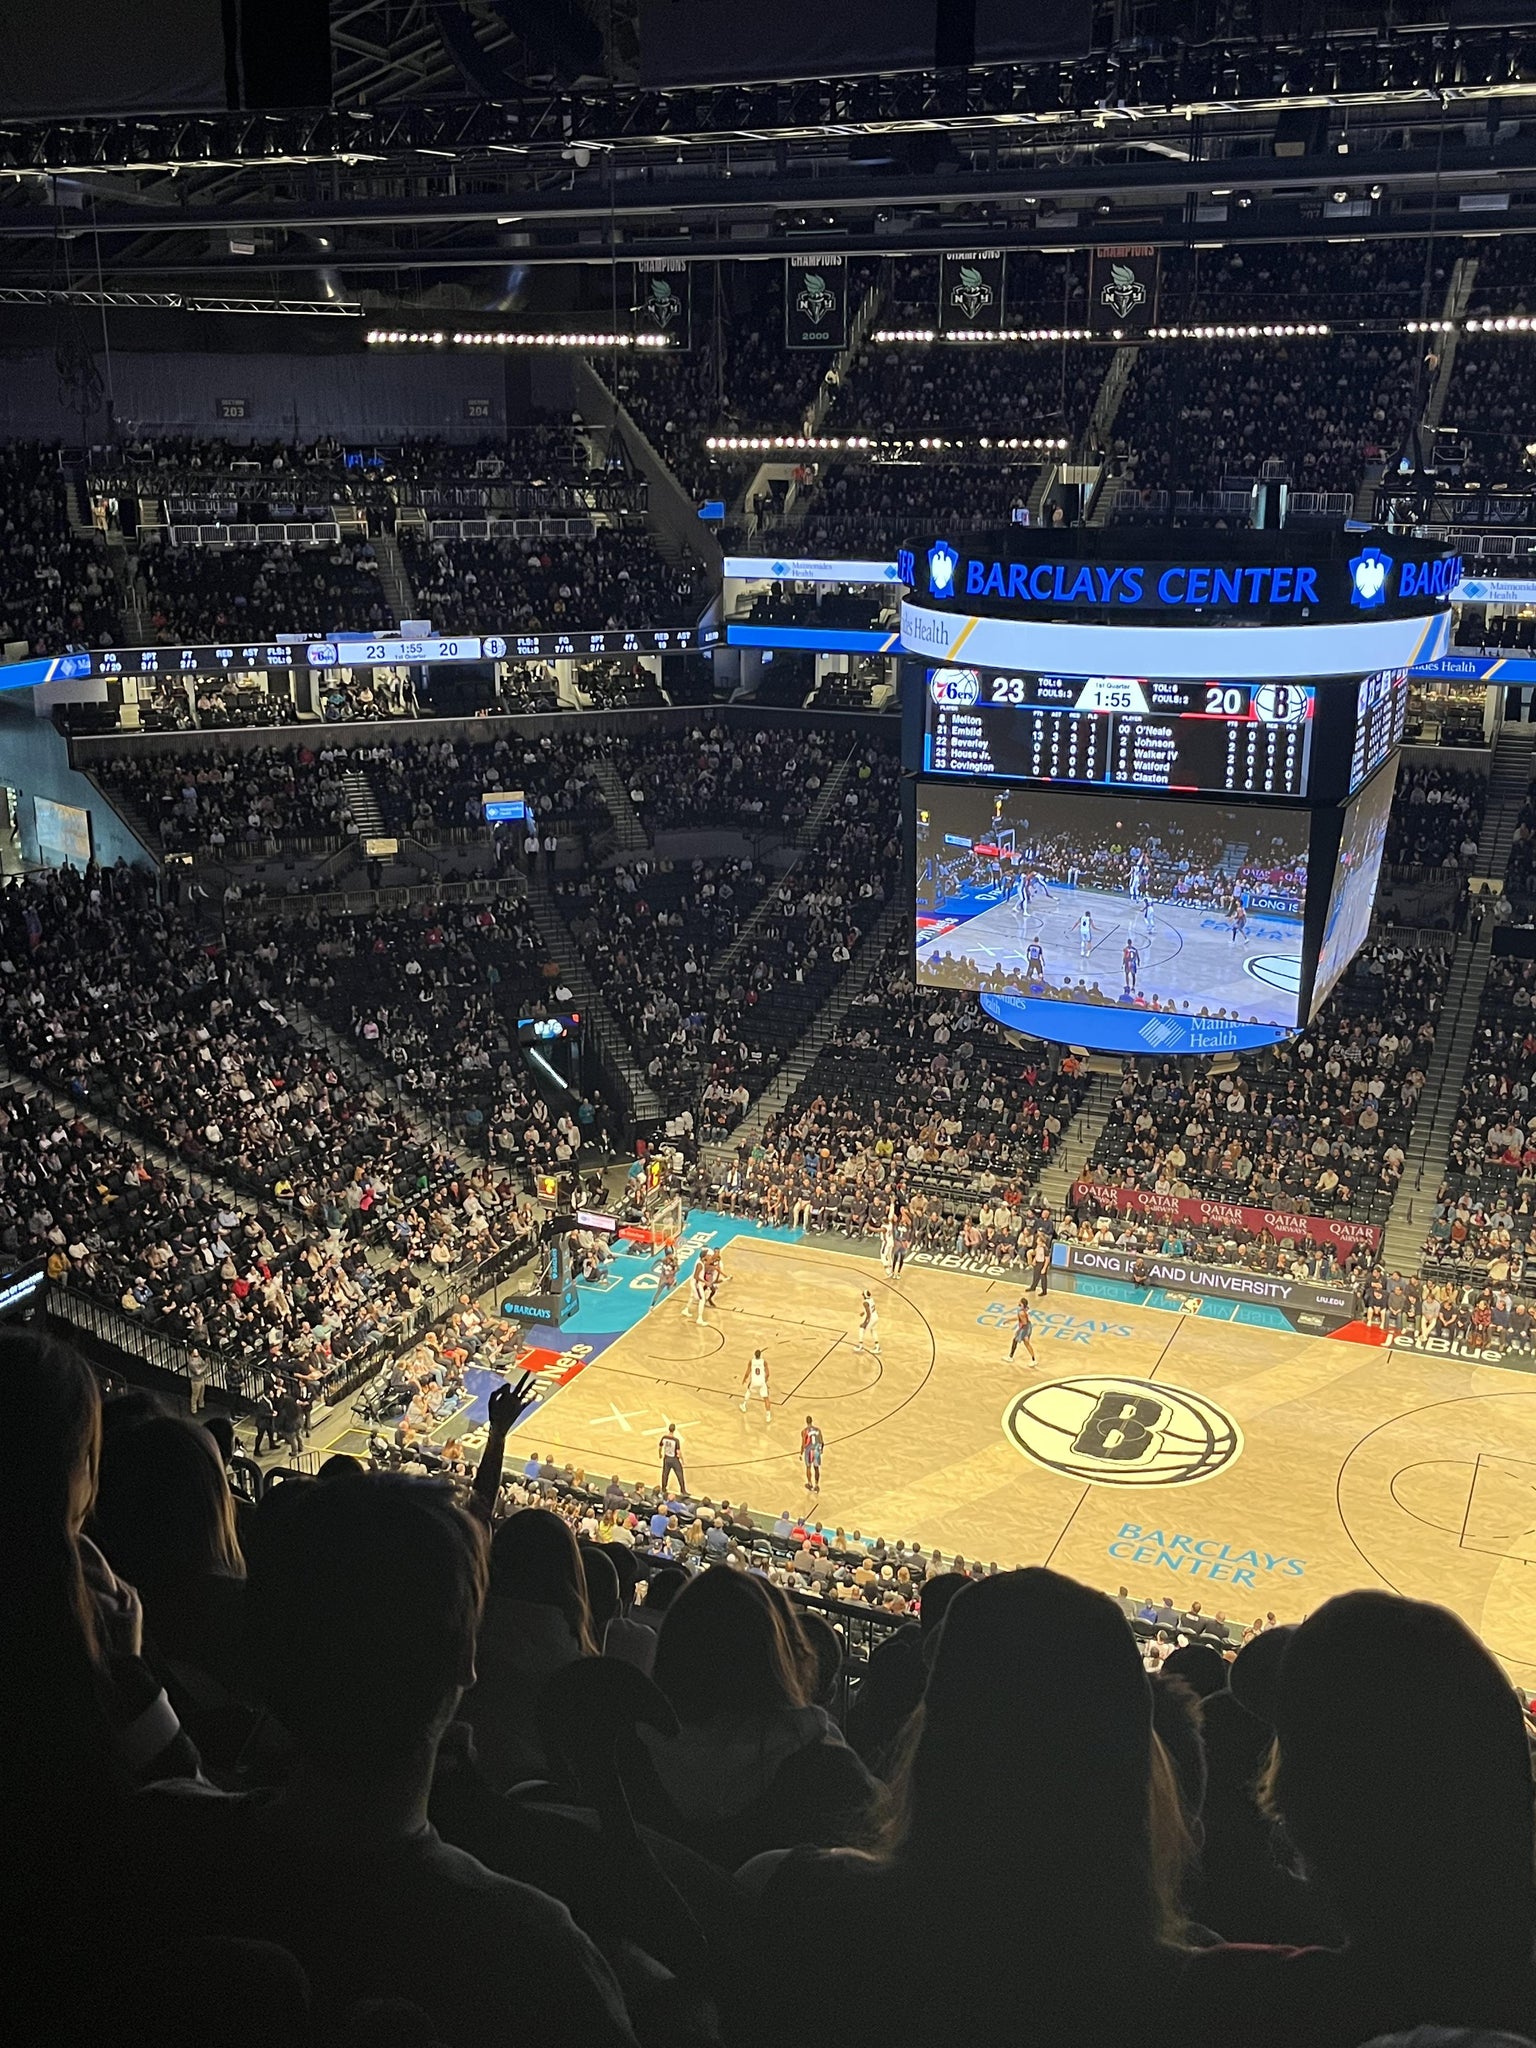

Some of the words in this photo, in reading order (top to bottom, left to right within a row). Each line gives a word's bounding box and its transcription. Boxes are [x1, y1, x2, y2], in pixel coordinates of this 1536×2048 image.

[638, 259, 686, 272] CHAMPIONS
[802, 332, 829, 340] 2000
[222, 406, 244, 417] 203
[468, 406, 489, 416] 204
[966, 560, 1144, 603] BARCLAYS
[1158, 567, 1320, 604] CENTER
[1490, 592, 1518, 600] Health
[914, 616, 949, 646] Health
[242, 648, 258, 657] AST
[366, 646, 386, 659] 23
[400, 644, 422, 654] 1:55
[440, 642, 458, 656] 20
[1441, 661, 1476, 672] Health
[936, 682, 973, 700] 76ers
[992, 676, 1024, 703] 23
[1205, 688, 1242, 714] 20
[1272, 687, 1291, 719] B
[1094, 692, 1131, 708] 1:55
[952, 714, 982, 726] Melton
[1054, 720, 1060, 730] 1
[1070, 722, 1078, 731] 4
[1090, 722, 1096, 732] 1
[937, 725, 947, 734] 21
[1032, 731, 1044, 740] 13
[1052, 732, 1058, 742] 3
[1070, 733, 1077, 742] 3
[1090, 734, 1095, 744] 1
[1118, 724, 1130, 734] 00
[1229, 730, 1236, 740] 0
[1248, 732, 1256, 741] 0
[1268, 732, 1276, 742] 0
[1288, 734, 1296, 743] 0
[936, 737, 947, 746] 22
[1034, 742, 1040, 752] 0
[1052, 744, 1058, 754] 0
[1070, 745, 1076, 754] 0
[1088, 746, 1094, 756] 0
[1120, 736, 1127, 746] 2
[1134, 737, 1175, 748] Johnson
[1228, 742, 1236, 752] 2
[1248, 744, 1255, 753] 0
[1268, 744, 1274, 754] 0
[1287, 746, 1294, 756] 0
[936, 748, 946, 757] 25
[951, 748, 978, 760] House
[1033, 754, 1040, 764] 0
[1052, 756, 1058, 764] 1
[1069, 756, 1076, 766] 0
[1088, 758, 1094, 767] 0
[1134, 748, 1166, 760] Walker
[1167, 750, 1178, 760] IV
[1228, 754, 1234, 764] 2
[1247, 756, 1254, 766] 0
[1268, 757, 1274, 766] 1
[1286, 758, 1294, 768] 0
[935, 759, 946, 768] 33
[950, 760, 994, 772] Covington
[1033, 766, 1040, 775] 0
[1050, 766, 1057, 776] 0
[1068, 768, 1076, 778] 0
[1086, 769, 1093, 779] 0
[1134, 760, 1170, 772] Watford
[1226, 766, 1234, 776] 0
[1248, 768, 1253, 778] 1
[1266, 768, 1273, 778] 0
[1285, 770, 1292, 780] 0
[1116, 771, 1128, 780] 33
[1132, 772, 1168, 784] Claxton
[1226, 778, 1233, 788] 2
[1245, 780, 1252, 790] 0
[1286, 782, 1292, 792] 1
[1252, 898, 1286, 910] LONG
[1190, 1031, 1237, 1048] Health
[1078, 1184, 1118, 1200] QATAR
[1138, 1193, 1179, 1208] QATAR
[1200, 1203, 1242, 1219] QATAR
[1264, 1213, 1308, 1228] QATAR
[1274, 1225, 1307, 1236] AIRWAYS
[1329, 1223, 1374, 1238] QATAR
[903, 1251, 1006, 1276] jetBlue
[1073, 1251, 1121, 1272] LONG
[1125, 1258, 1186, 1283] ISAND
[1189, 1272, 1292, 1299] UNIVERSITY
[1316, 1295, 1345, 1306] LIU.EDU
[514, 1305, 550, 1318] BARCLAYS
[1380, 1332, 1502, 1362] jetBlue
[536, 1344, 594, 1379] Nets
[1070, 1390, 1174, 1466] B
[1118, 1523, 1306, 1576] BARCLAYS
[1108, 1542, 1258, 1588] CENTER
